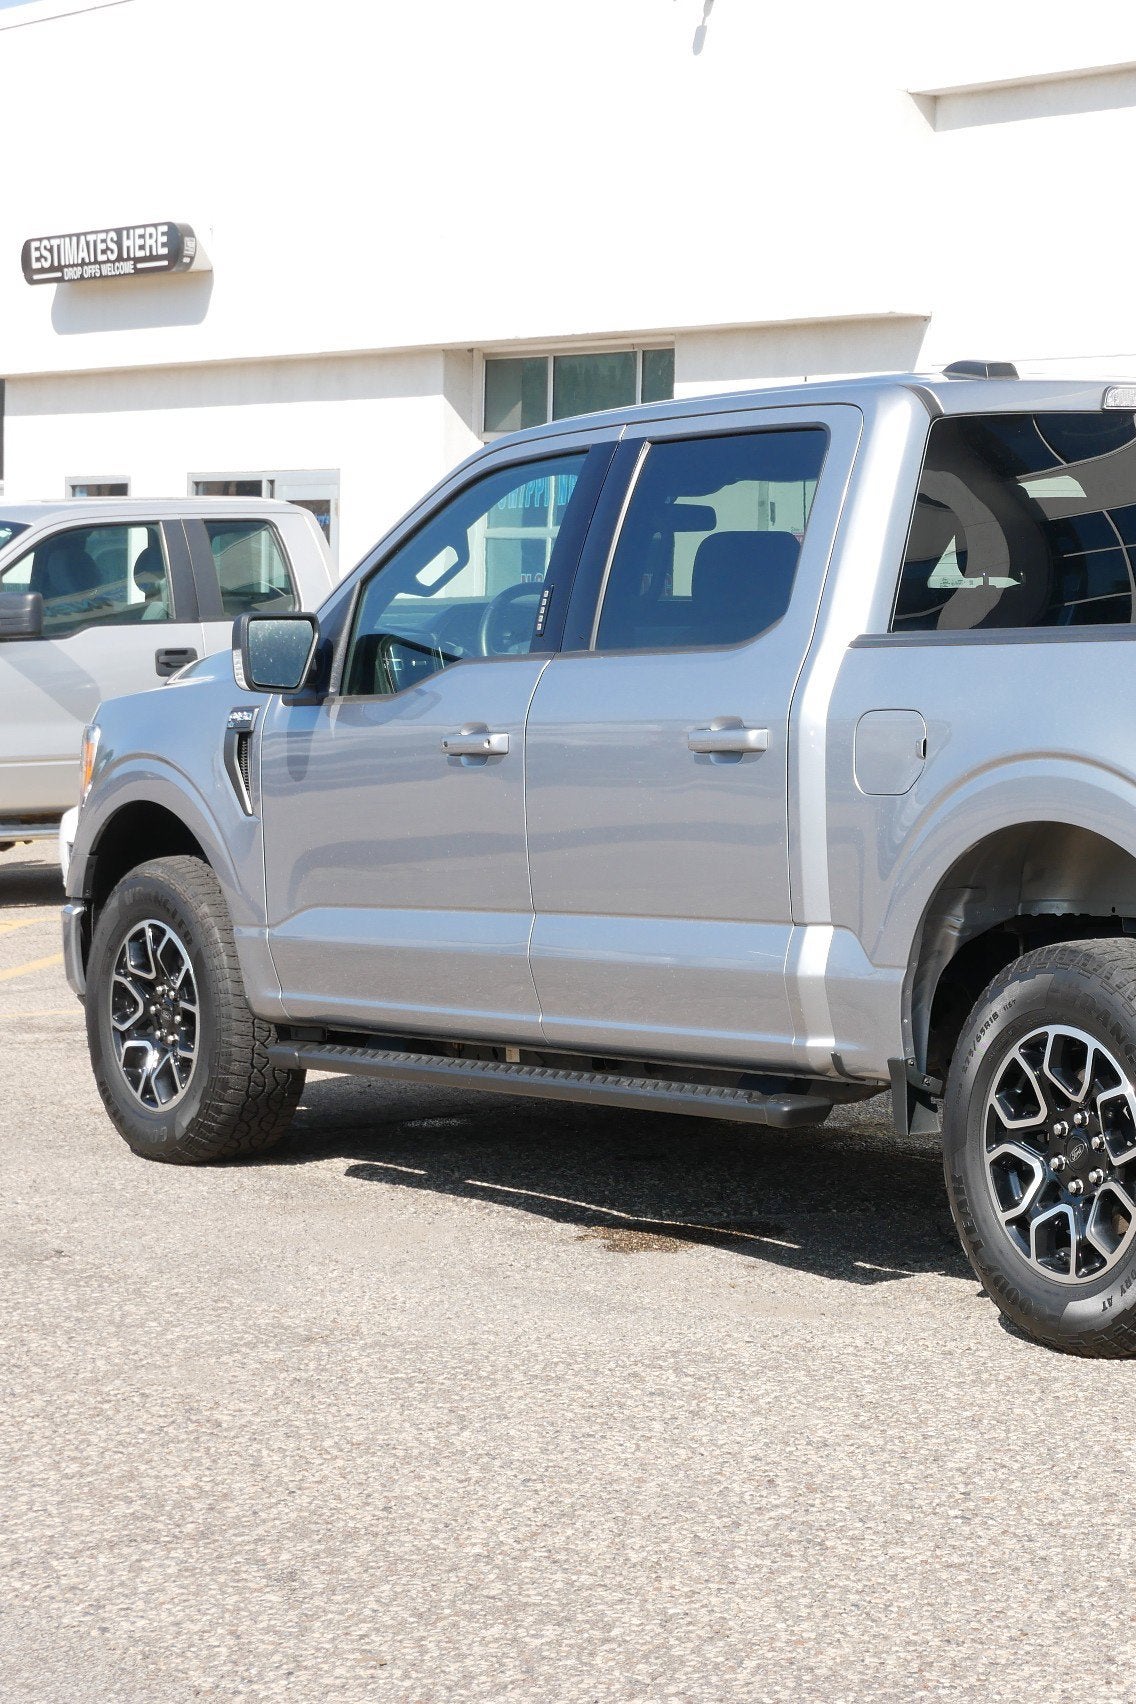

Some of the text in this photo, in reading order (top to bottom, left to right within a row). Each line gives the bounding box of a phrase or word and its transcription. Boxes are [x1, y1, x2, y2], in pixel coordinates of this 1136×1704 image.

[30, 231, 118, 269] ESTIMATES
[122, 225, 169, 259] HERE
[63, 261, 135, 281] DROP OFFS WELCOME
